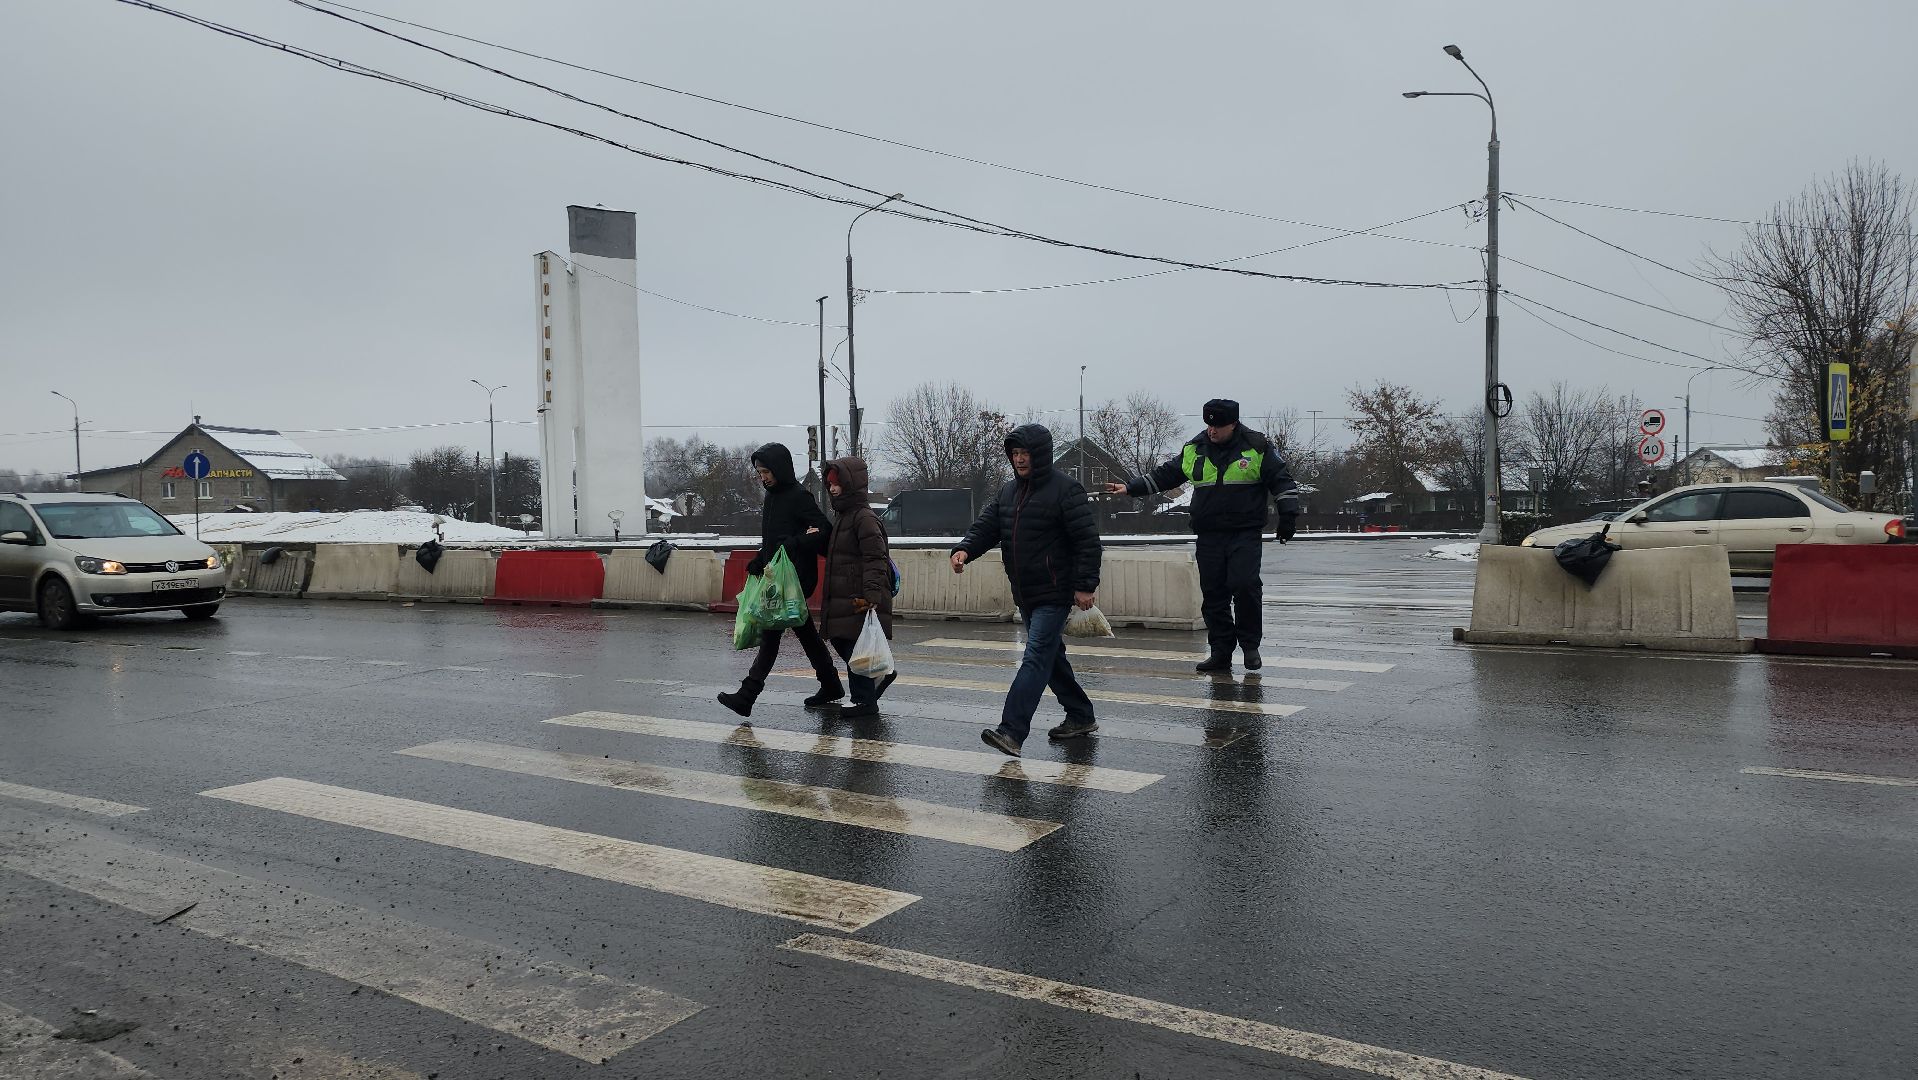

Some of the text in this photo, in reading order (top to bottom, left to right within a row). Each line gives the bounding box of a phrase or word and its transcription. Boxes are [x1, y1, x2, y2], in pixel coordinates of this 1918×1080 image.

[542, 261, 552, 403] НОГИНСК
[1643, 445, 1659, 456] 40
[206, 469, 253, 478] АПЧАСТИ
